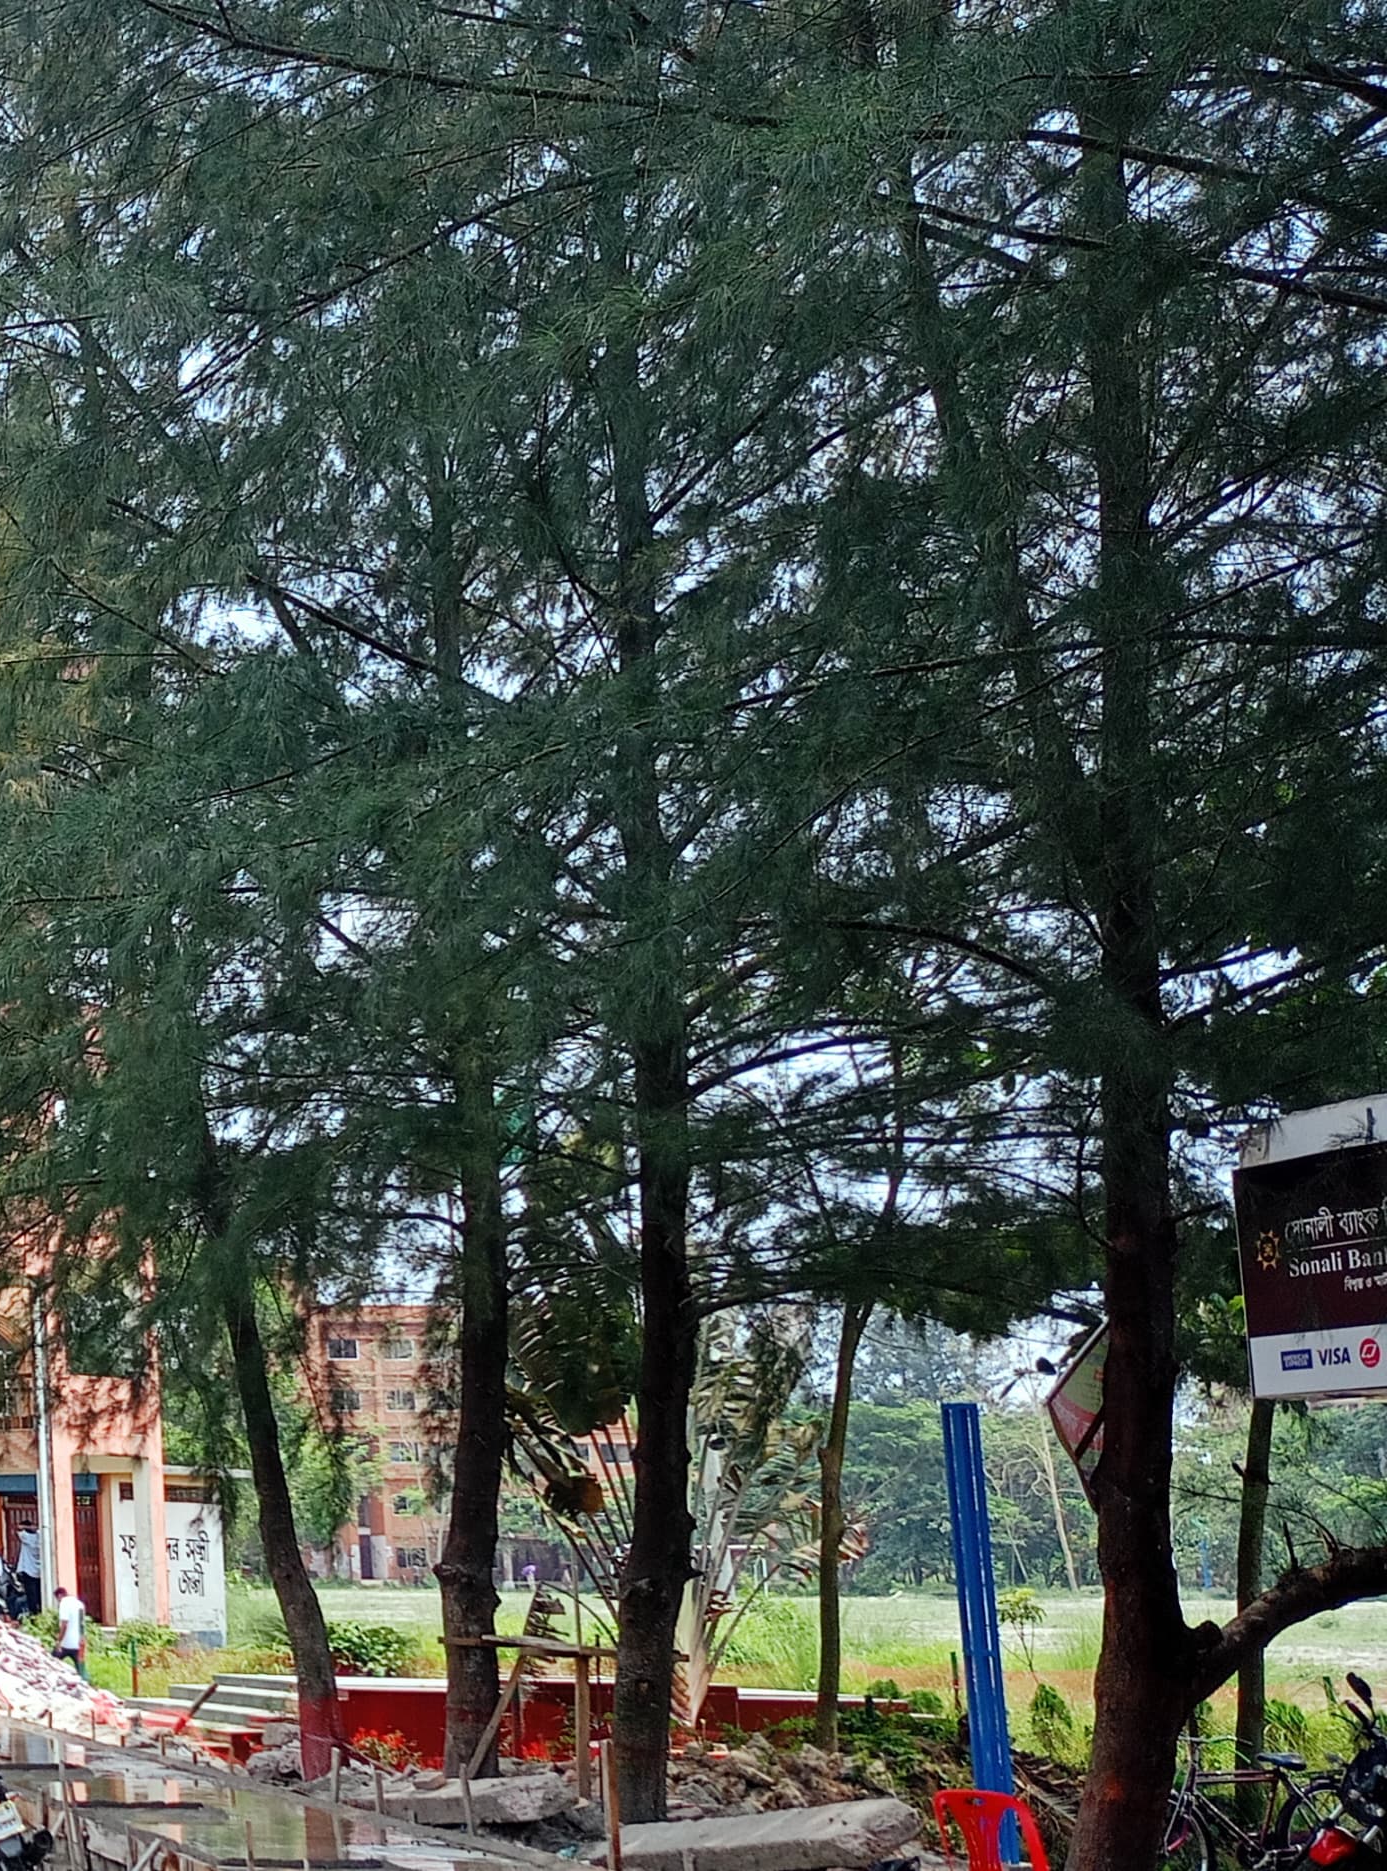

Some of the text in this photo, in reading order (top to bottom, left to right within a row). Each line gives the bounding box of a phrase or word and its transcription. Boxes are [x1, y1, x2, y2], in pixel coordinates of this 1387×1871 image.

[1289, 1247, 1387, 1278] Sonali Ban
[1317, 1347, 1351, 1366] VISA
